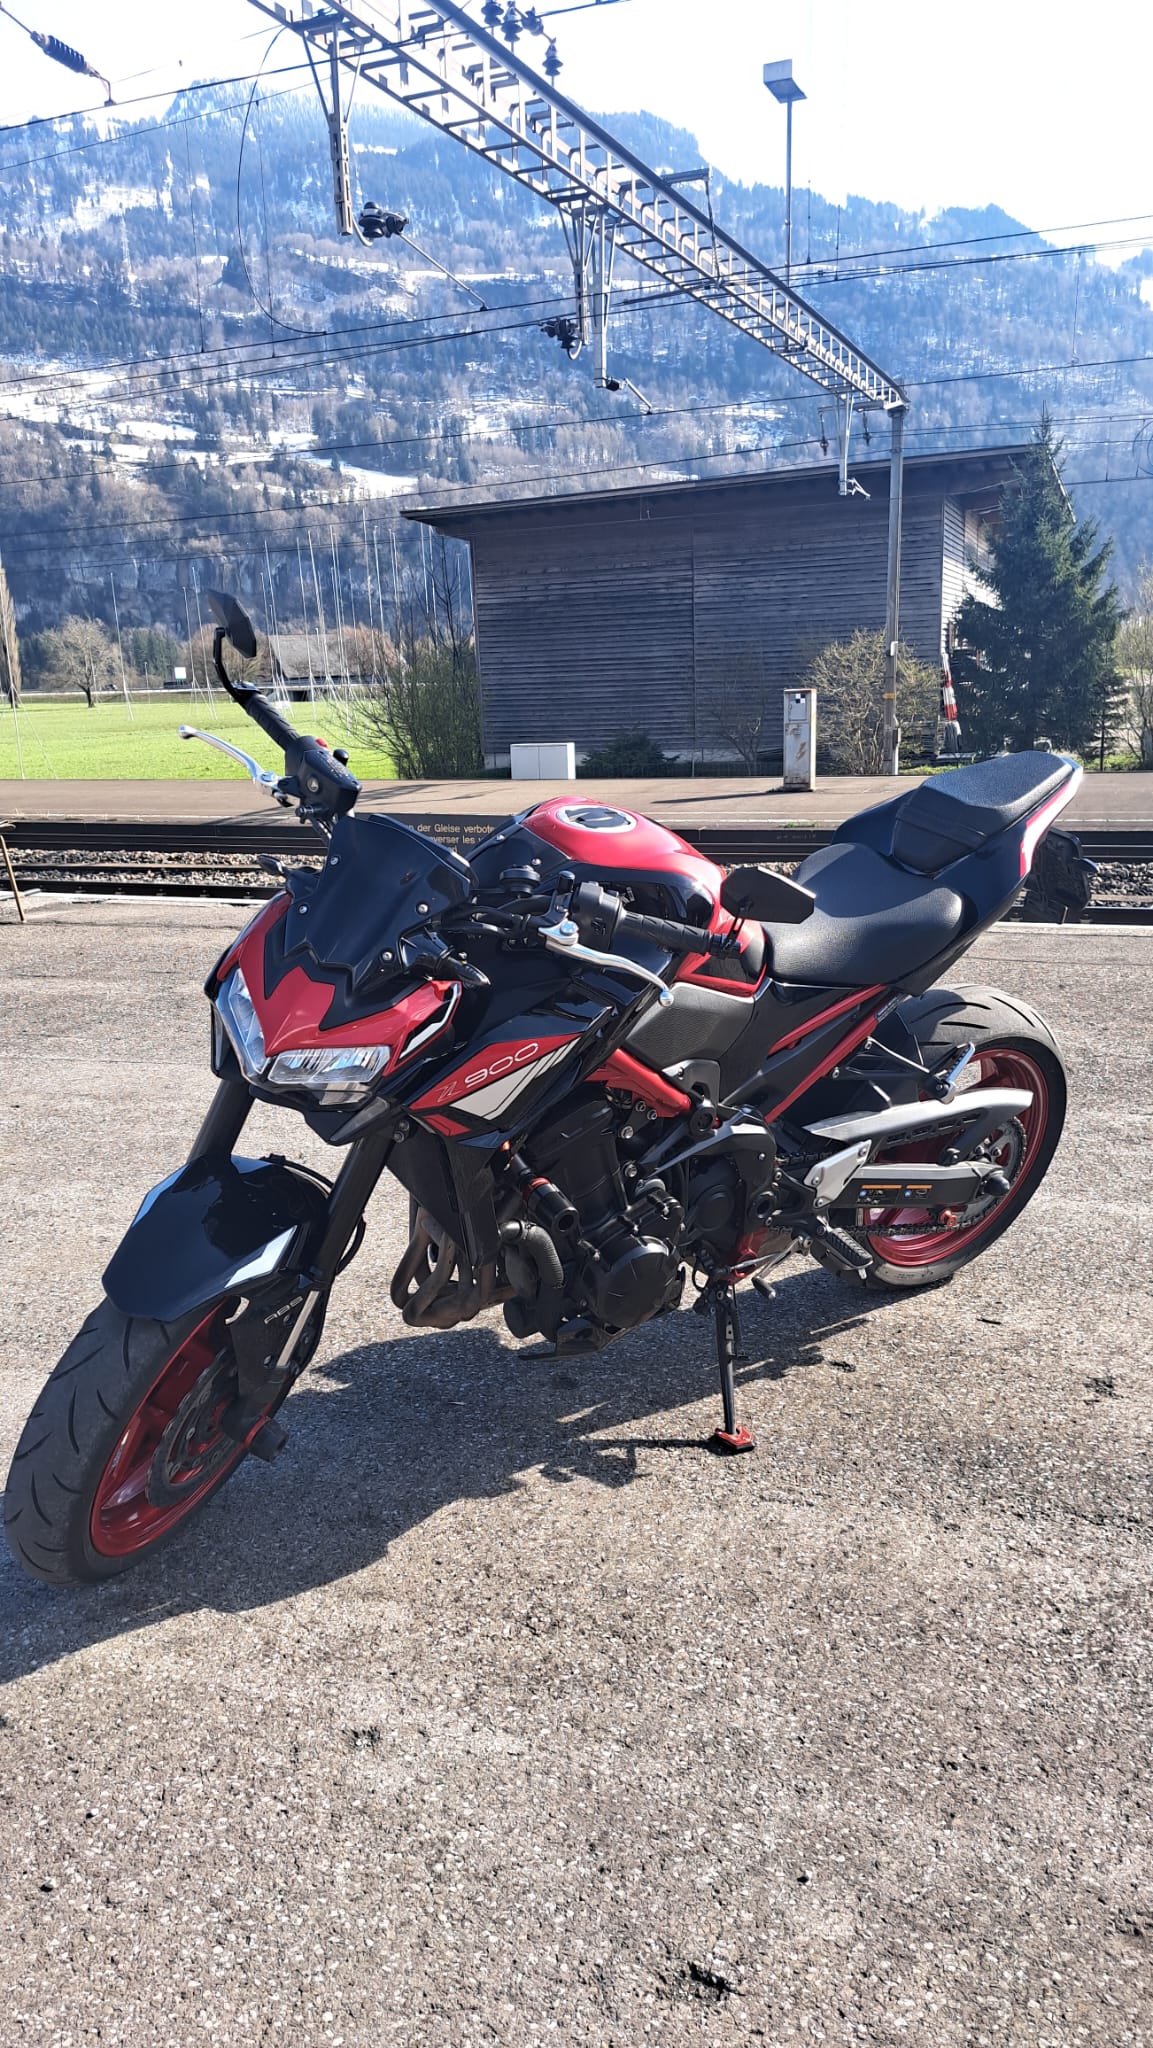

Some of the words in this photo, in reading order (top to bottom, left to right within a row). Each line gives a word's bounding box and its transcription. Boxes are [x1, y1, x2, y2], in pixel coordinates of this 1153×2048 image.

[417, 824, 431, 832] der
[434, 823, 460, 833] Gleise
[463, 824, 495, 833] verbote
[462, 835, 475, 843] les
[264, 1296, 303, 1325] ABS
